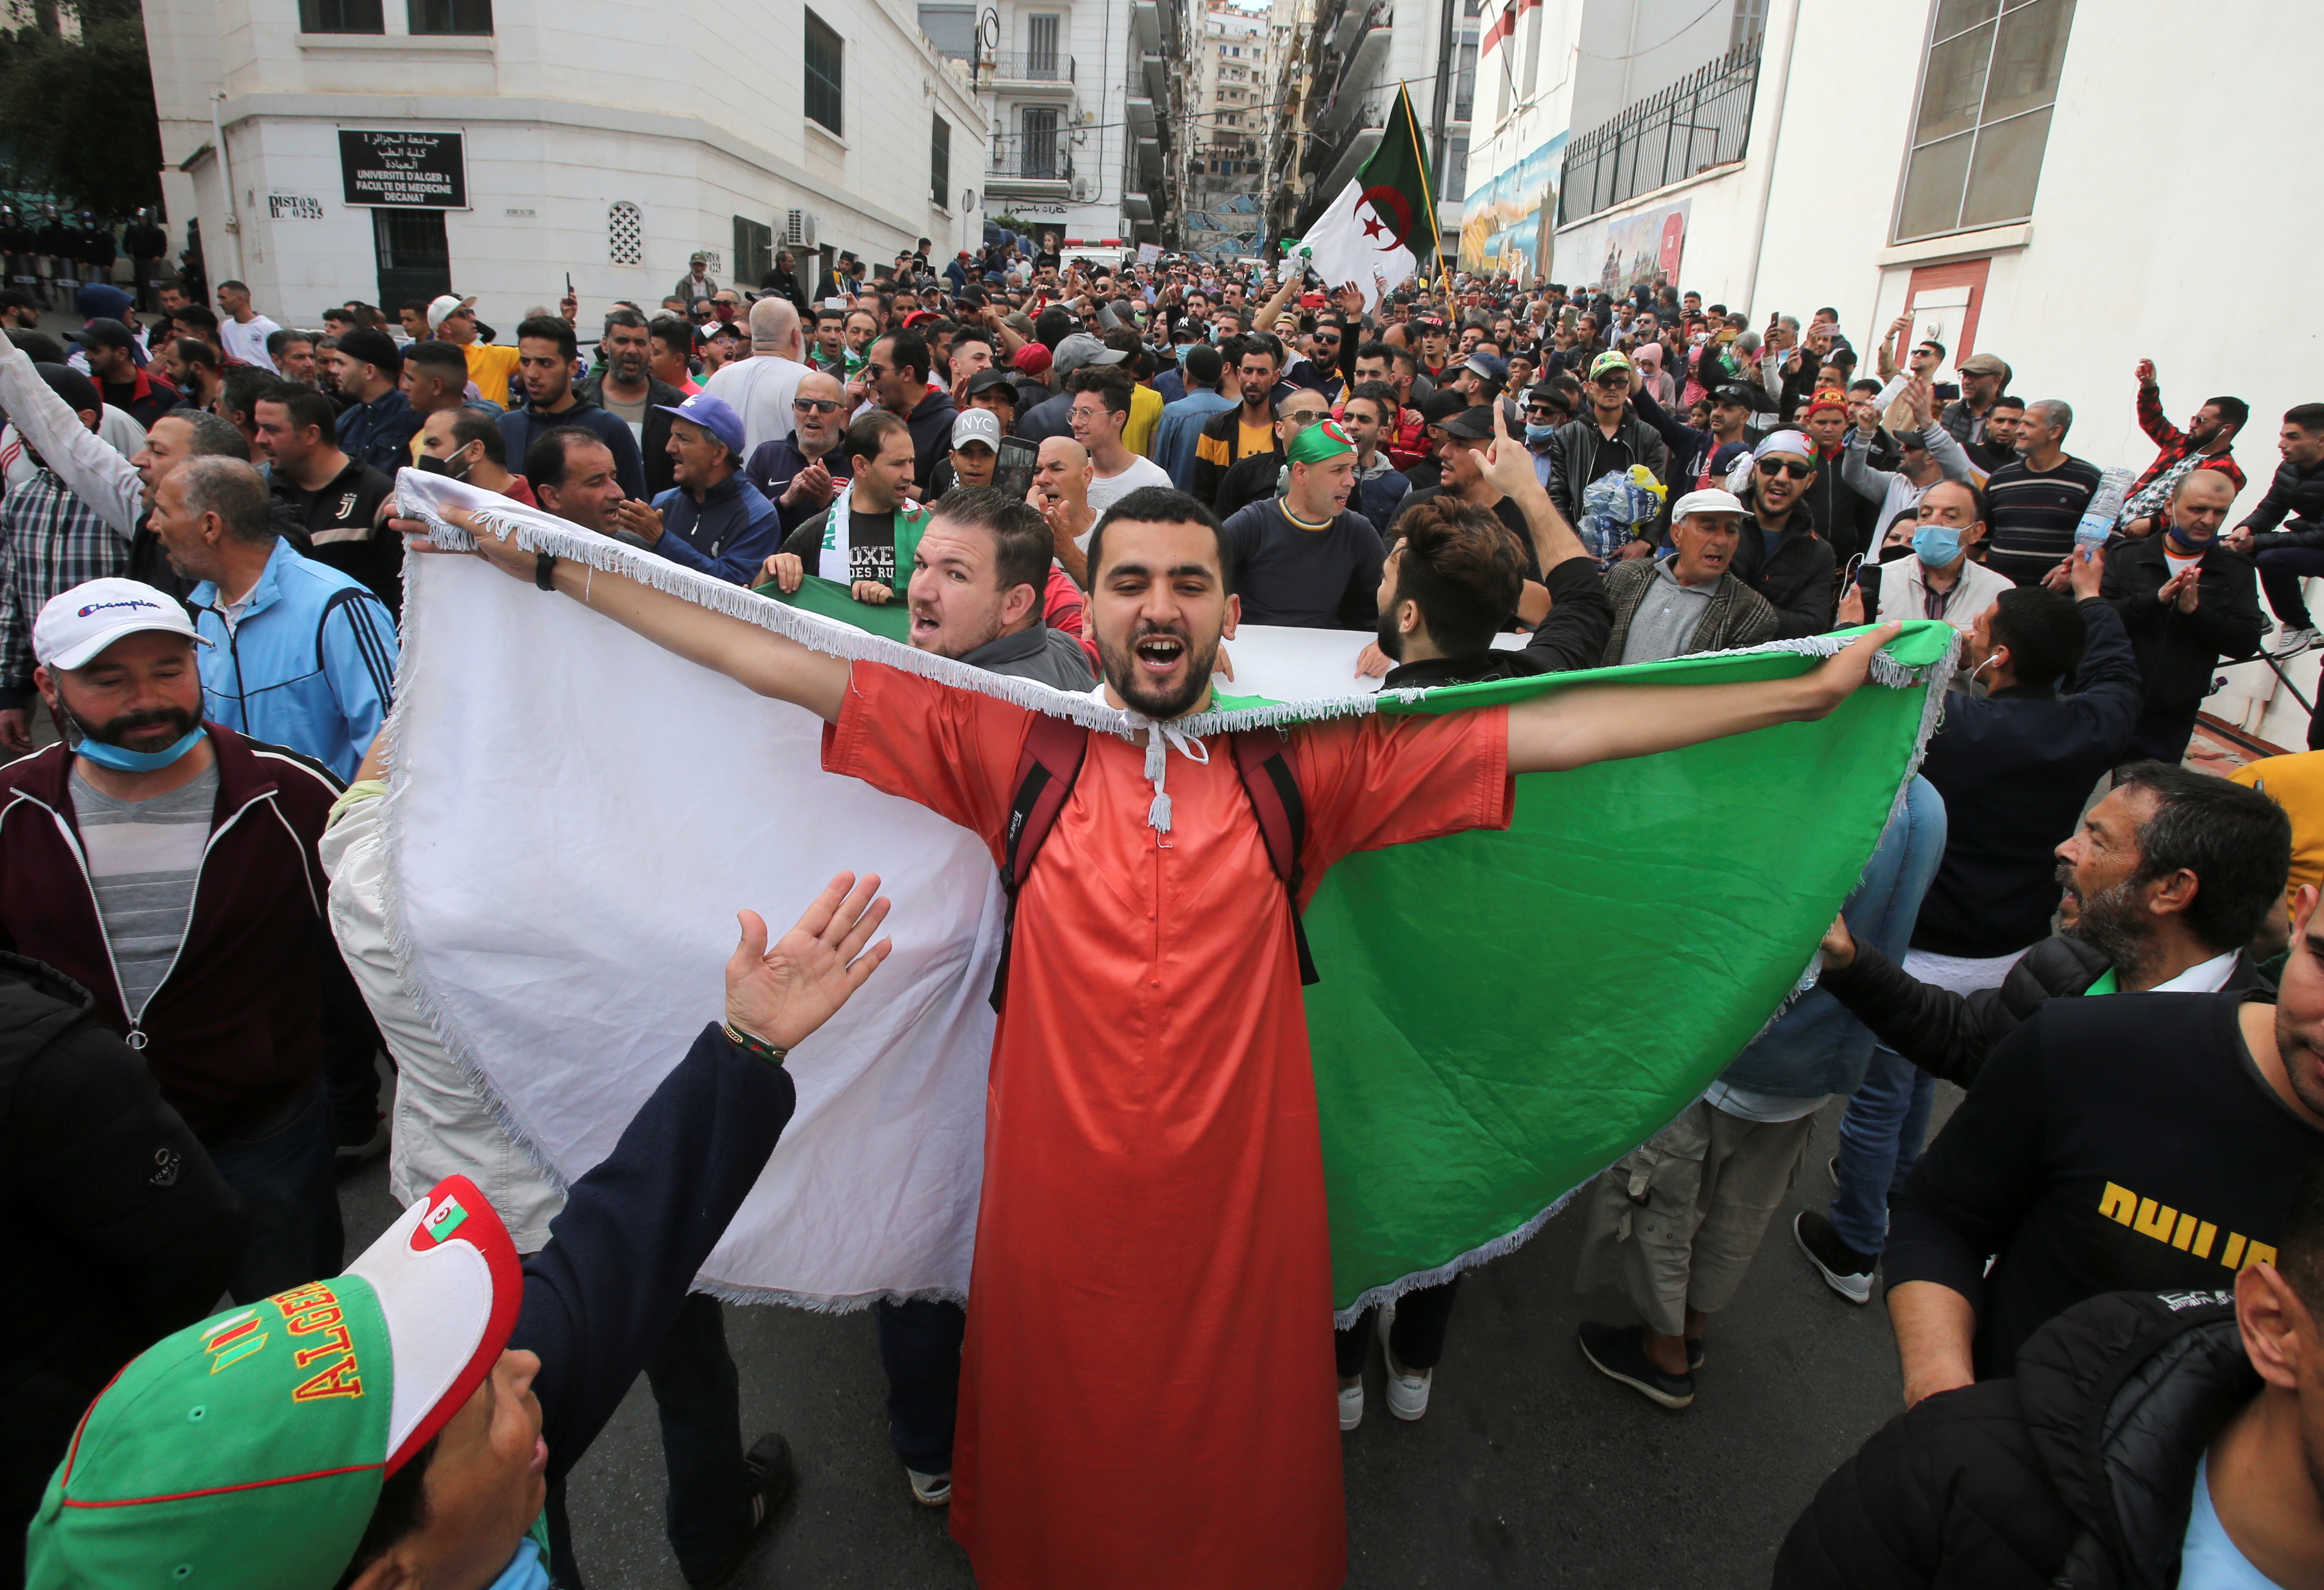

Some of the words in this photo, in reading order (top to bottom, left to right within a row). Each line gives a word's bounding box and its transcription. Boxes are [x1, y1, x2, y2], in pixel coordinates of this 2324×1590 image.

[372, 133, 404, 146] الجزائر
[407, 133, 439, 147] جامعة
[378, 147, 404, 160] الطب
[406, 147, 427, 160] كلية
[357, 169, 405, 181] UNIVERSITE
[406, 171, 442, 182] D'ALGER
[444, 174, 451, 183] 1
[356, 181, 394, 191] FACULTE
[395, 182, 407, 191] DE
[407, 183, 452, 194] MEDECINE
[269, 196, 298, 207] DIST
[384, 192, 425, 202] DECANAT
[293, 208, 323, 219] 0225
[962, 415, 993, 432] NYC
[78, 599, 162, 617] Champion
